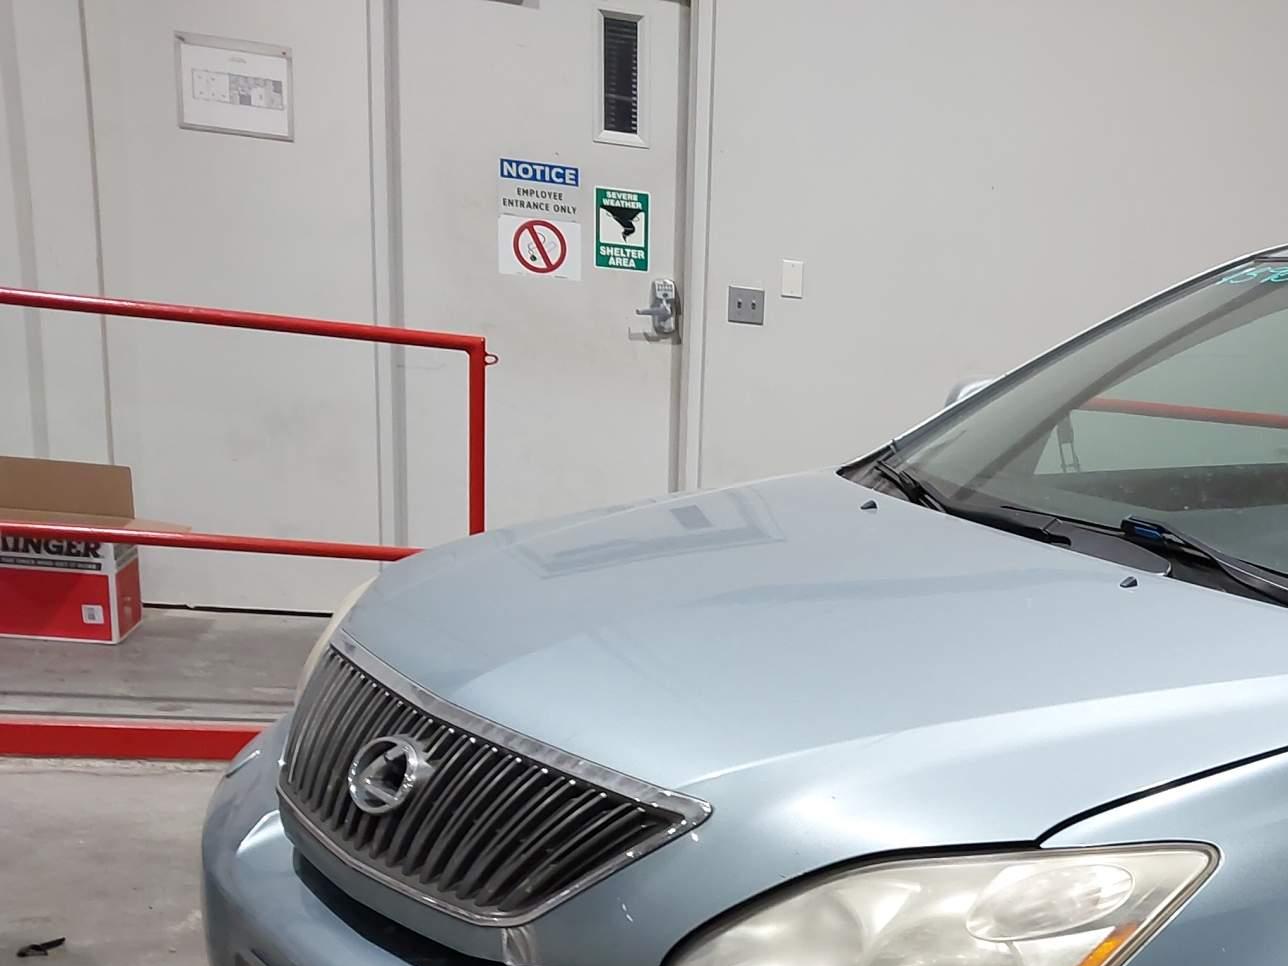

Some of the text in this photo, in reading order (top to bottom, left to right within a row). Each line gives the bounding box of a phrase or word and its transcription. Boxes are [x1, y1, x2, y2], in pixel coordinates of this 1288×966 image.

[502, 161, 577, 185] NOTICE
[516, 187, 564, 201] EMPLOYEE
[605, 190, 639, 202] SEVERE
[502, 197, 577, 215] ENTRANCE ONLY
[602, 198, 642, 209] WEATHER
[600, 245, 645, 260] SHELTER
[608, 256, 637, 268] AREA
